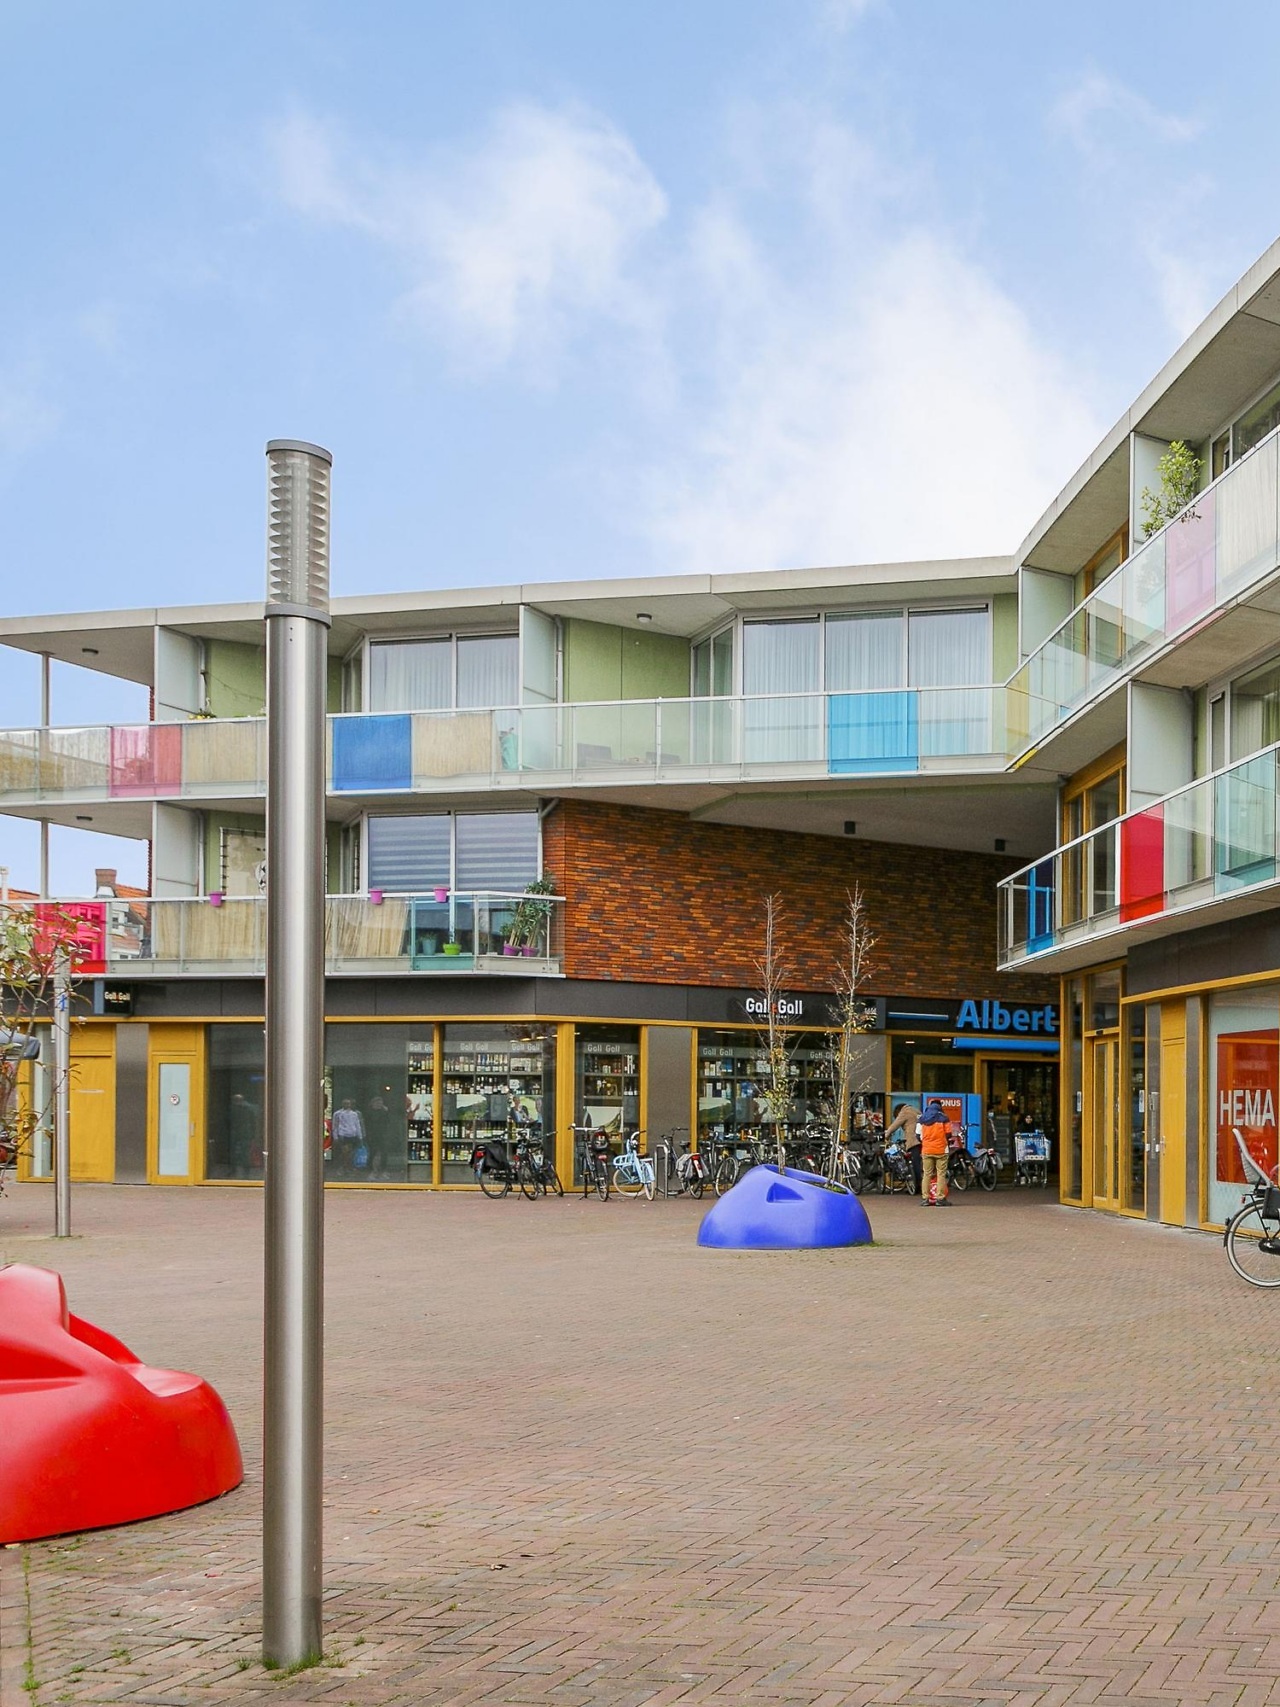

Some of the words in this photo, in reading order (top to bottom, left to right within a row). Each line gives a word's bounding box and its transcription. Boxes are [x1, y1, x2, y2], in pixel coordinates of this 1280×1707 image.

[778, 999, 803, 1015] Gall
[956, 999, 1056, 1032] Albert
[1219, 1089, 1276, 1127] HEMA
